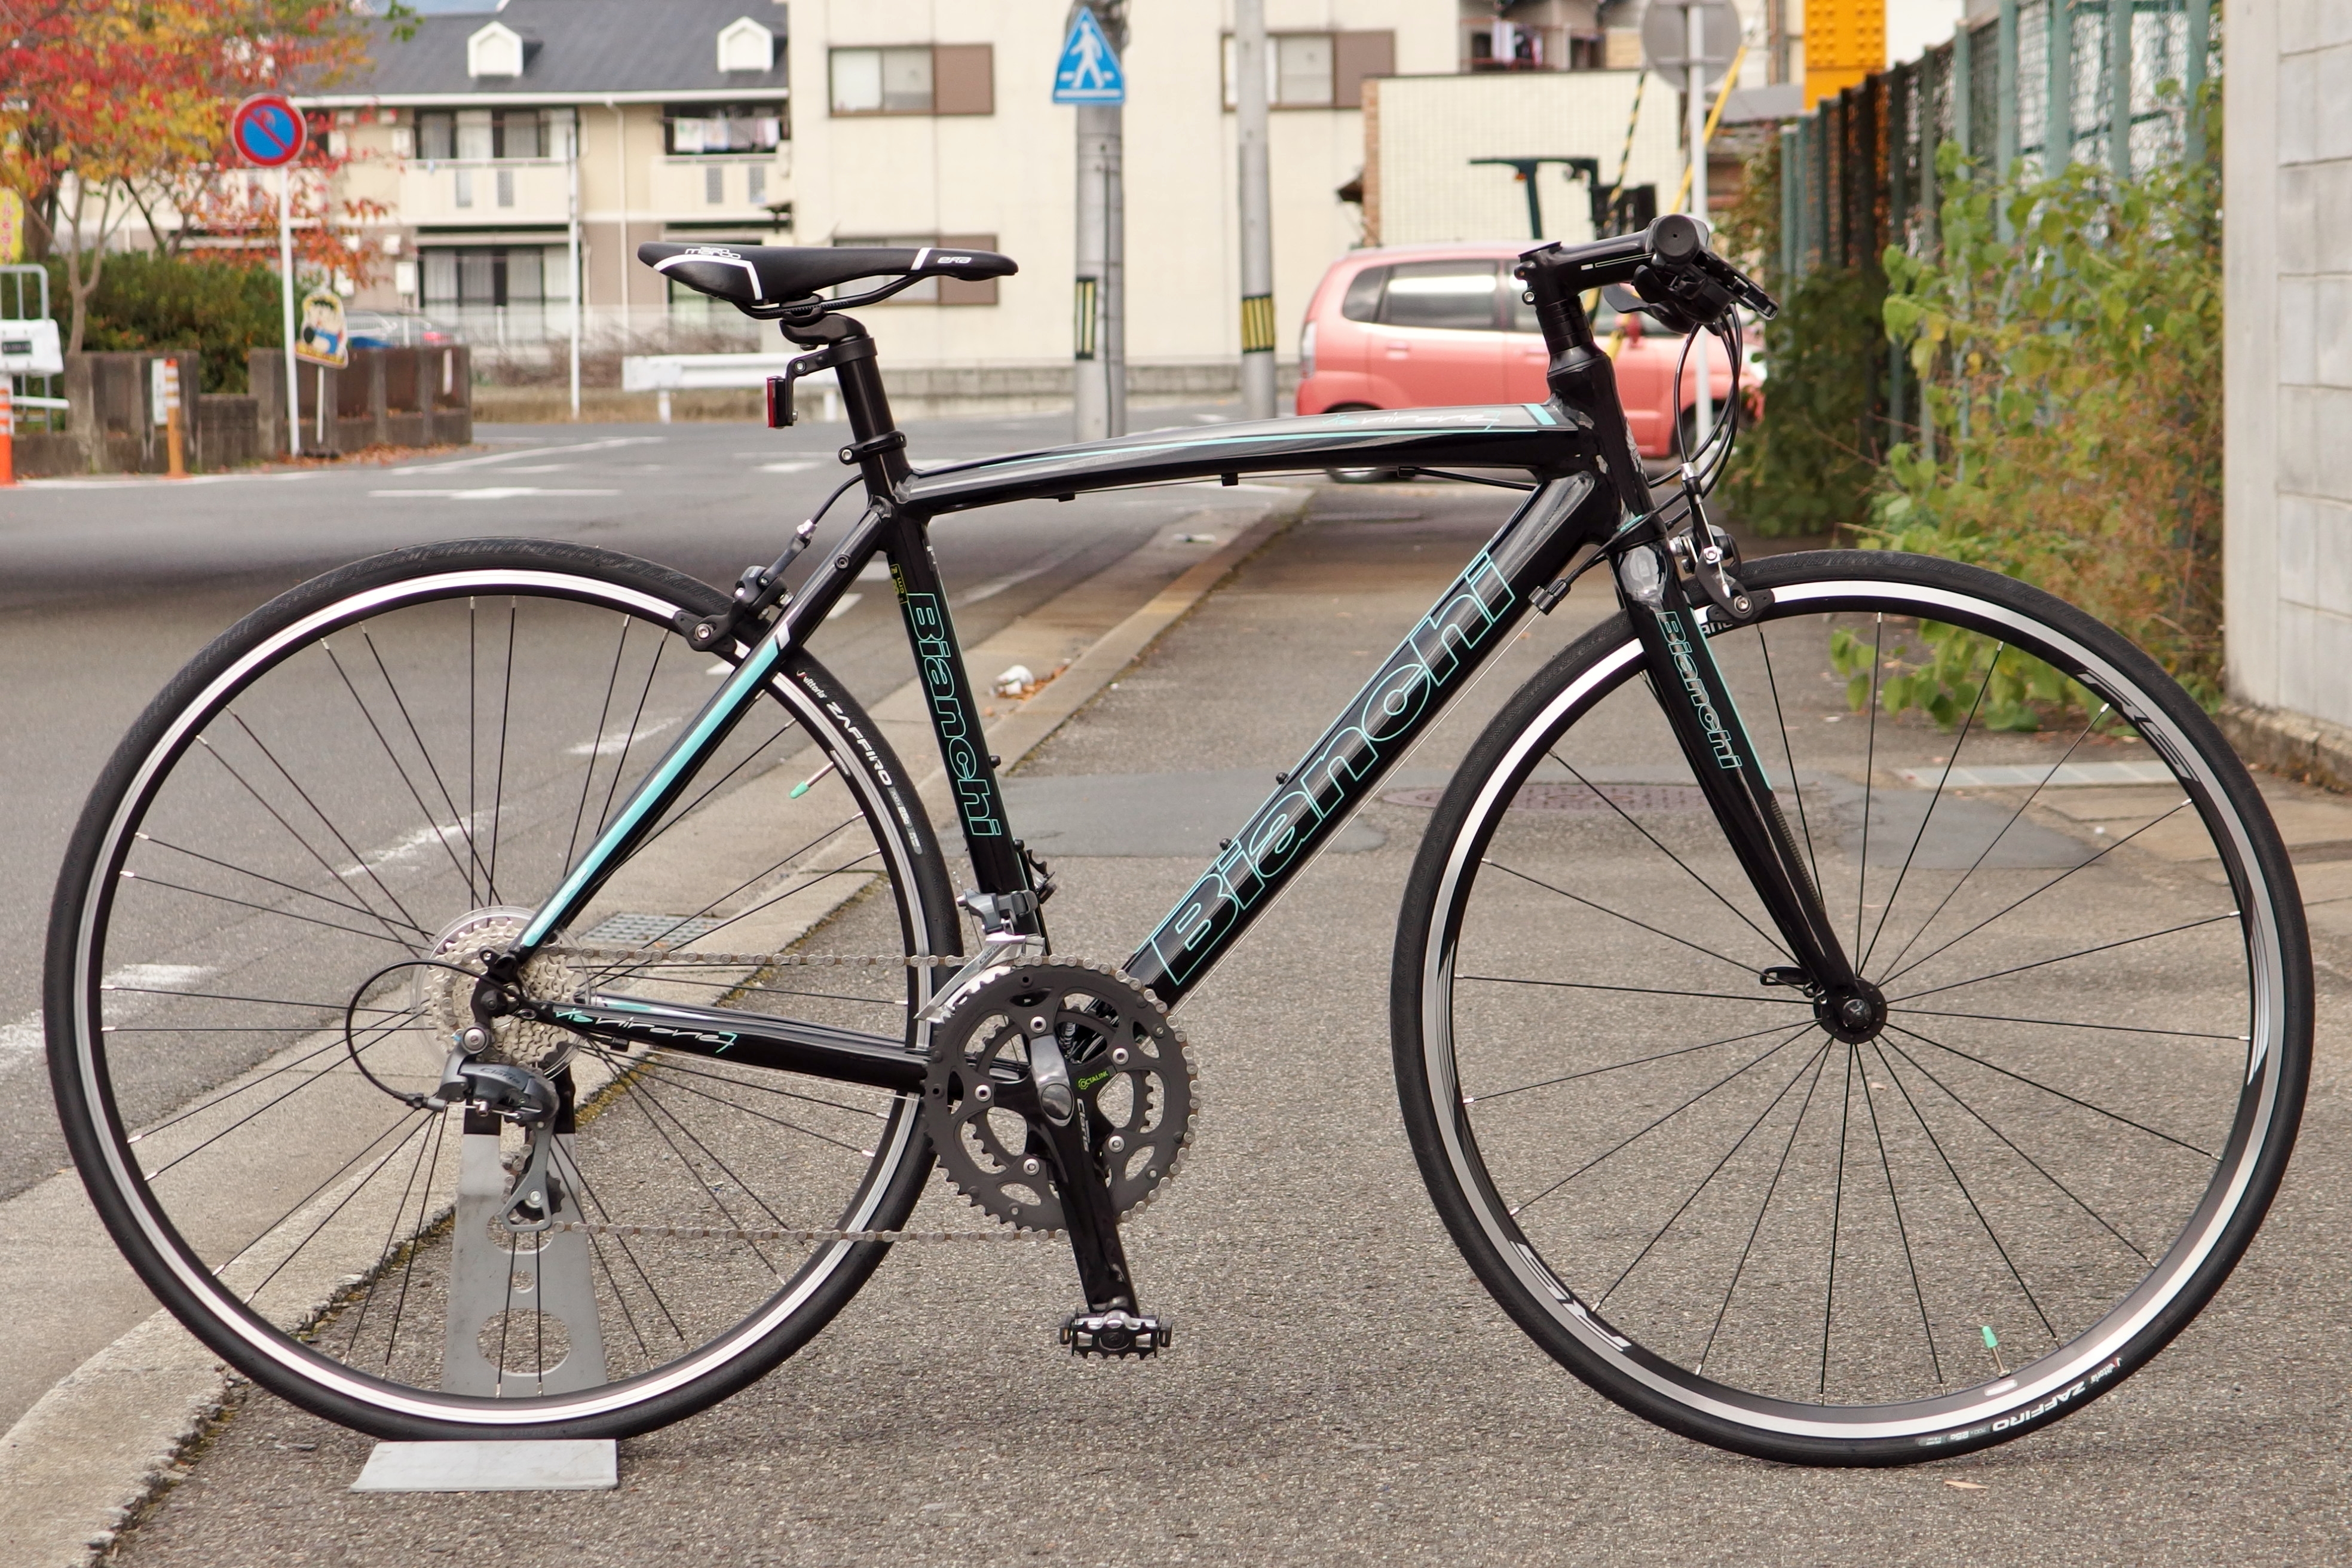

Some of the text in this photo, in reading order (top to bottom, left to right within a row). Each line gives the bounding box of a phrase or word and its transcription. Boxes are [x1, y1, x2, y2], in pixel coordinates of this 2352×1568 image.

[826, 701, 892, 787] ZAFFIRO
[906, 593, 1002, 835] Bianchi
[1656, 611, 1742, 768] Bianchi
[1151, 551, 1515, 985] Bianchi
[1078, 1071, 1108, 1089] OCTALINK
[1992, 1381, 2086, 1432] ZAFFIRO
